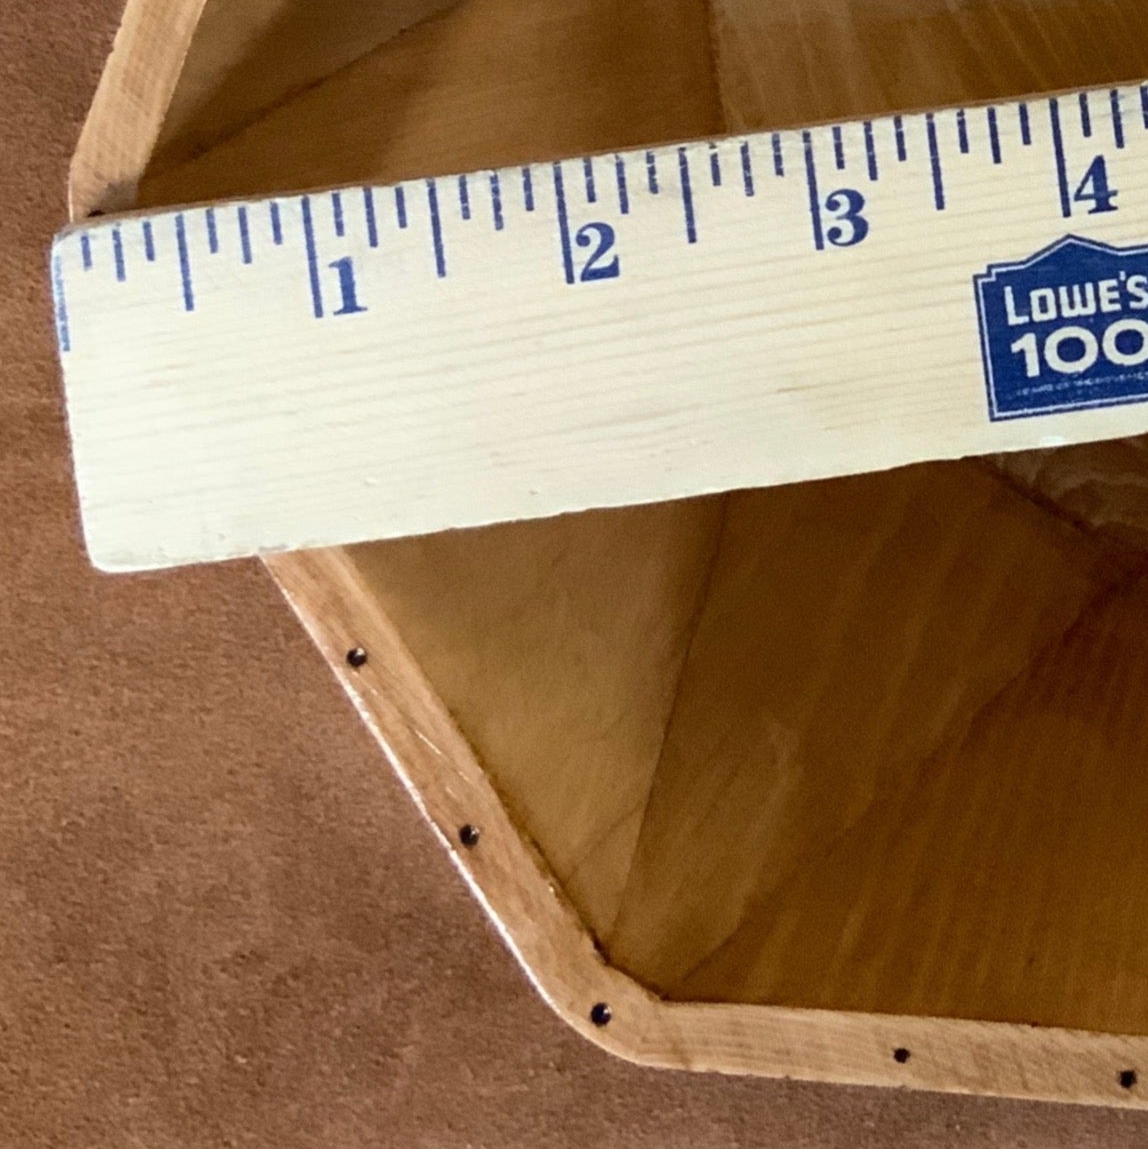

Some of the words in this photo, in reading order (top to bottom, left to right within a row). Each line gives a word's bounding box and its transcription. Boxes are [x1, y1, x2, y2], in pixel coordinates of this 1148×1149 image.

[329, 255, 368, 316] 1
[575, 222, 621, 282] 2
[825, 188, 870, 247] 3
[1073, 155, 1119, 215] 4
